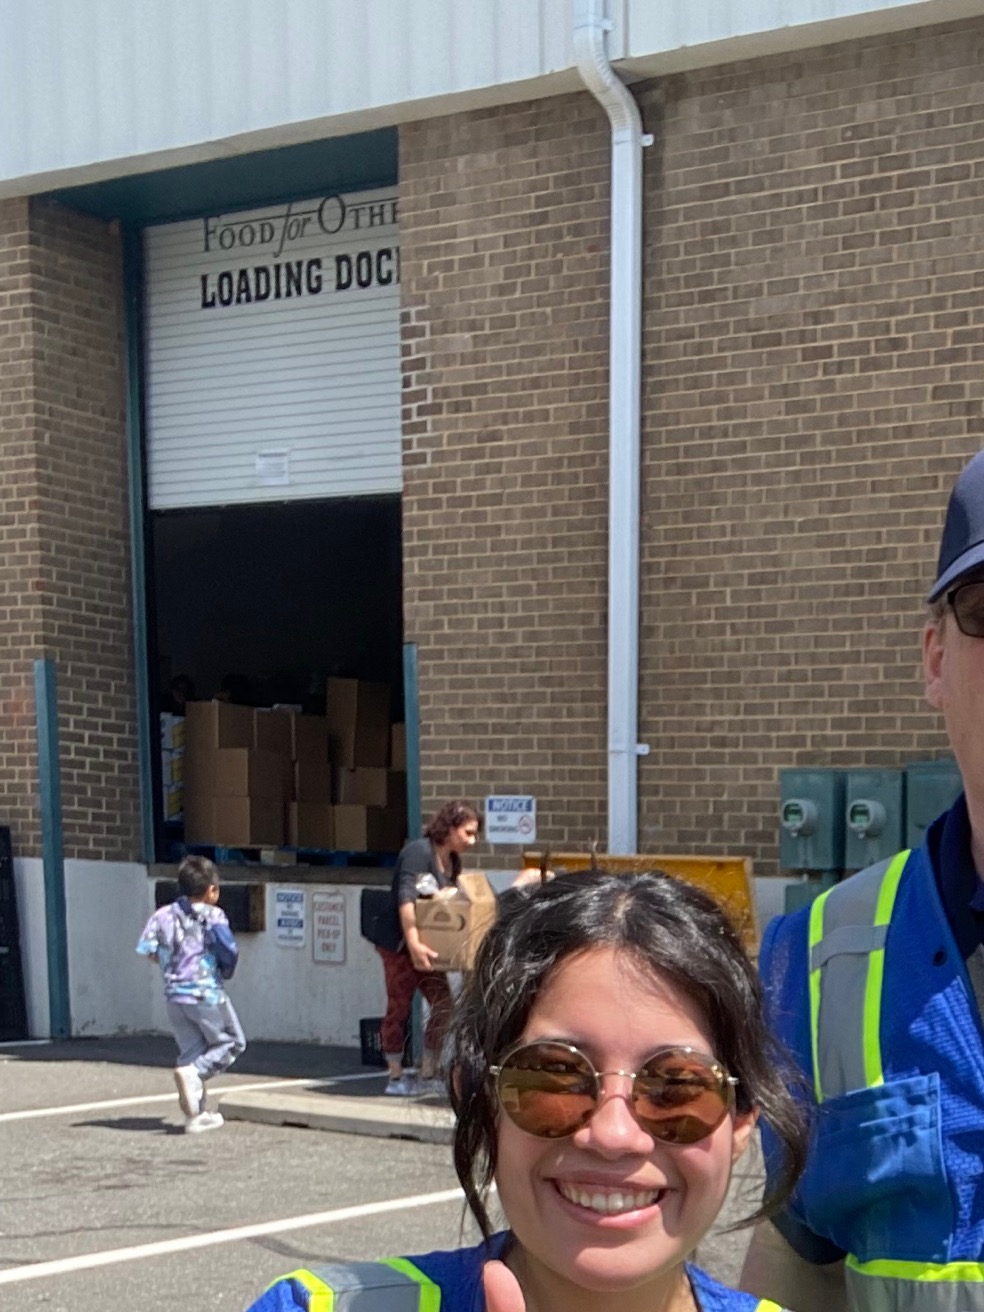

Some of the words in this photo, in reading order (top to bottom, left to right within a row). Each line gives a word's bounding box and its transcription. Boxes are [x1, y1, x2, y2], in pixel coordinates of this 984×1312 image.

[203, 216, 275, 252] FOOD
[273, 203, 312, 258] for
[201, 258, 322, 309] LOADING
[335, 246, 399, 290] DOC
[493, 799, 529, 811] NOTICE
